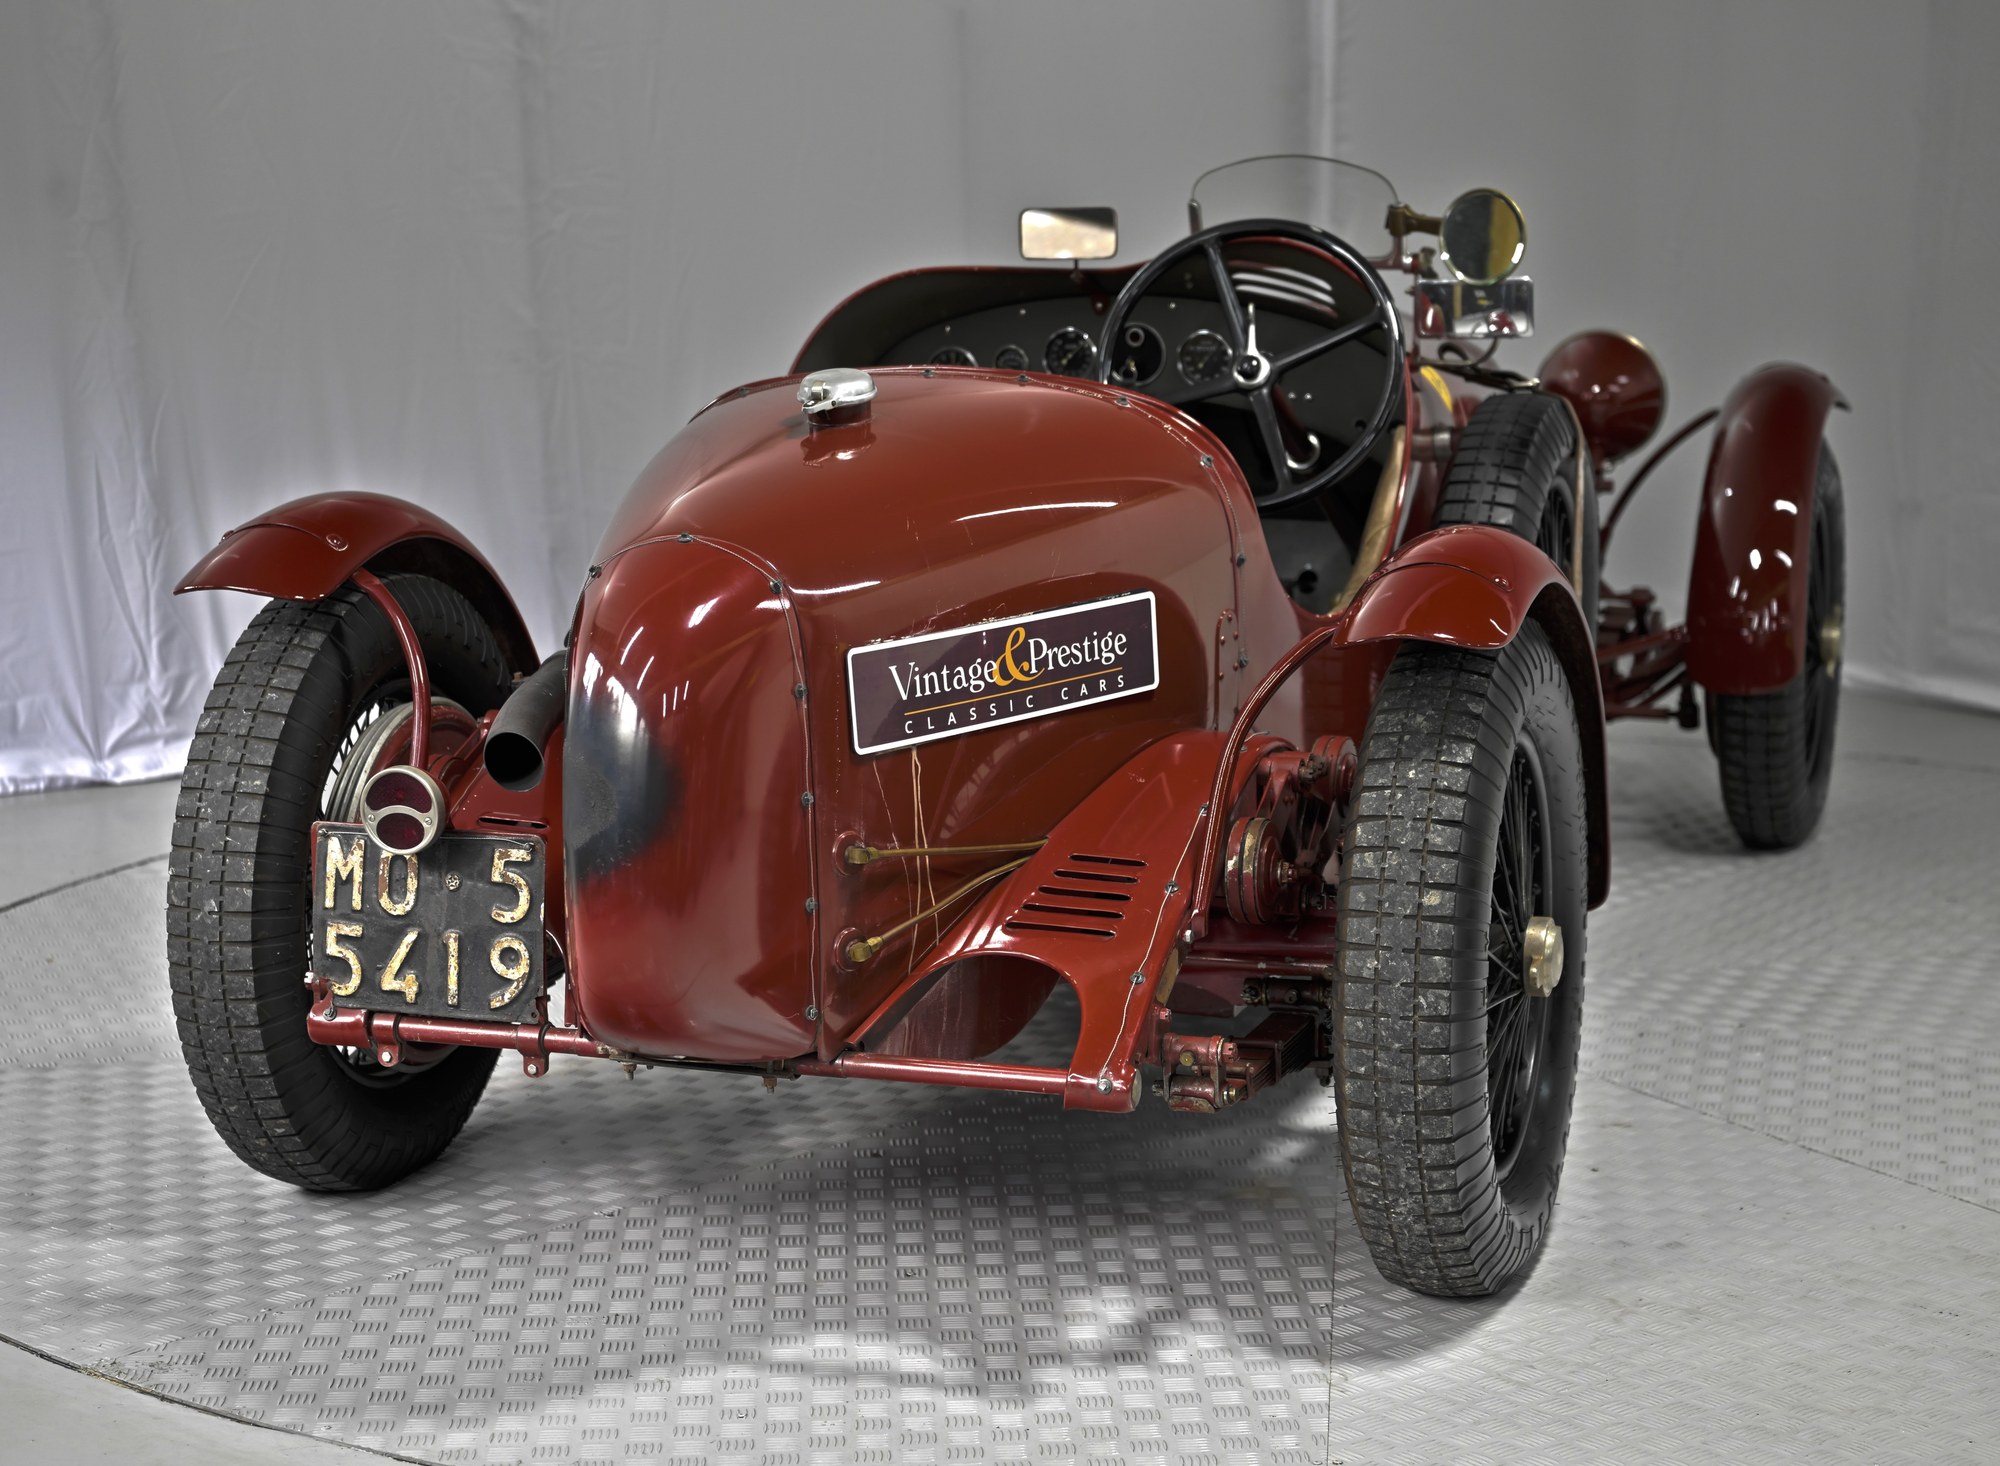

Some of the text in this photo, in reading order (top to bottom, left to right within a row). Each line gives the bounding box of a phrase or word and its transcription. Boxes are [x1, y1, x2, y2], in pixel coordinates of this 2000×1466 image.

[888, 626, 1127, 701] Vintage & Prestige
[904, 675, 1125, 734] CLASSIC CARS
[490, 848, 532, 924] 5
[325, 922, 531, 1010] 5419
